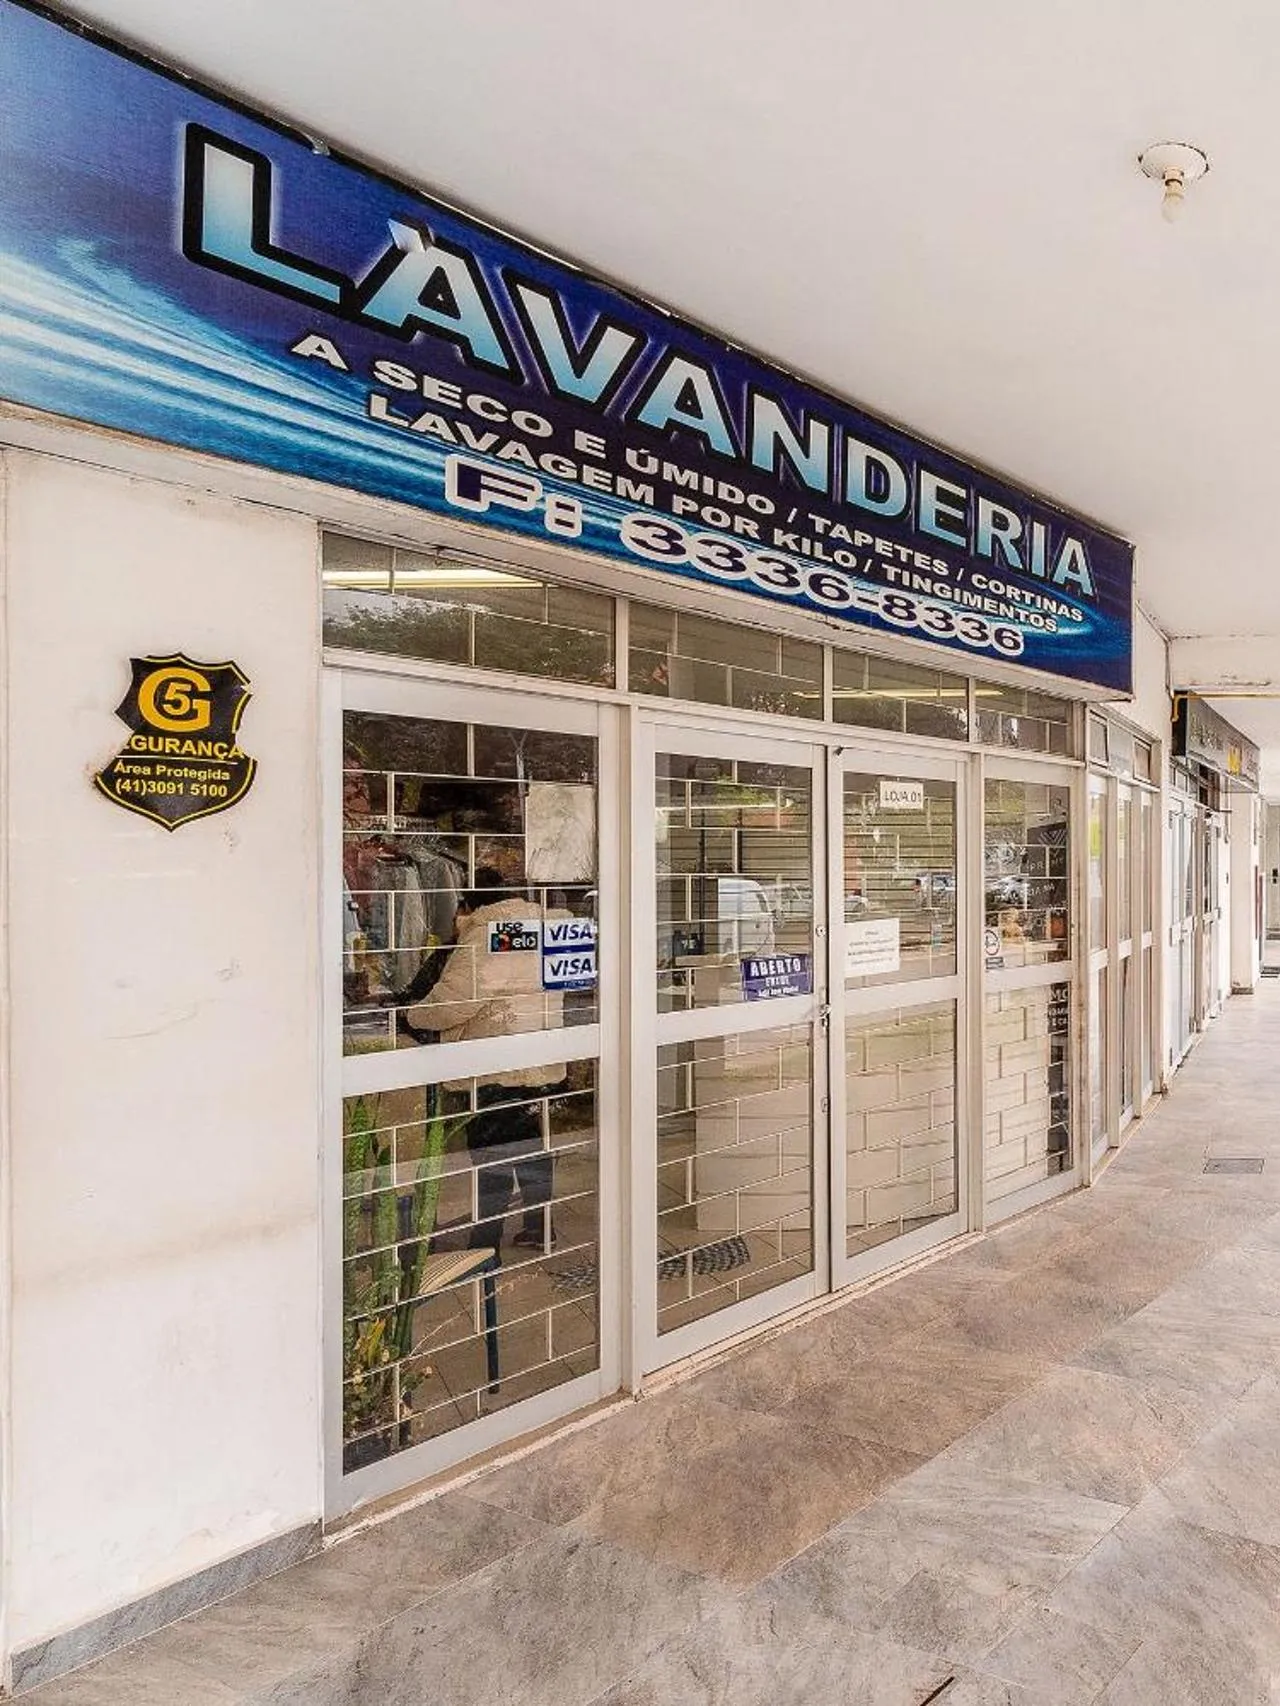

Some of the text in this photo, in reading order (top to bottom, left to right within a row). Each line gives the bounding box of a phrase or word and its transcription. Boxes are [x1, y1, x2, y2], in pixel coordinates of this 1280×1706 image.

[190, 132, 1096, 598] LAVANDERIA
[291, 334, 348, 370] A
[373, 360, 553, 437] SECO
[574, 428, 606, 459] E
[625, 447, 776, 515] ÚMIDO
[808, 513, 949, 574] TAPETES
[971, 573, 1084, 622] CORTINAS
[369, 395, 655, 506] LAVAGEM
[672, 495, 761, 540] POR
[774, 528, 857, 568] KILO
[882, 563, 1058, 633] TINGIMENTOS
[620, 512, 1024, 656] 3336-8336
[124, 735, 245, 760] GURANÇA
[114, 760, 230, 781] Área Protegida
[115, 779, 227, 798] (41)3091 5100
[496, 922, 523, 933] use
[549, 923, 593, 941] VISA
[512, 936, 536, 948] elo
[549, 958, 593, 976] VISA
[750, 958, 801, 977] ABERTO
